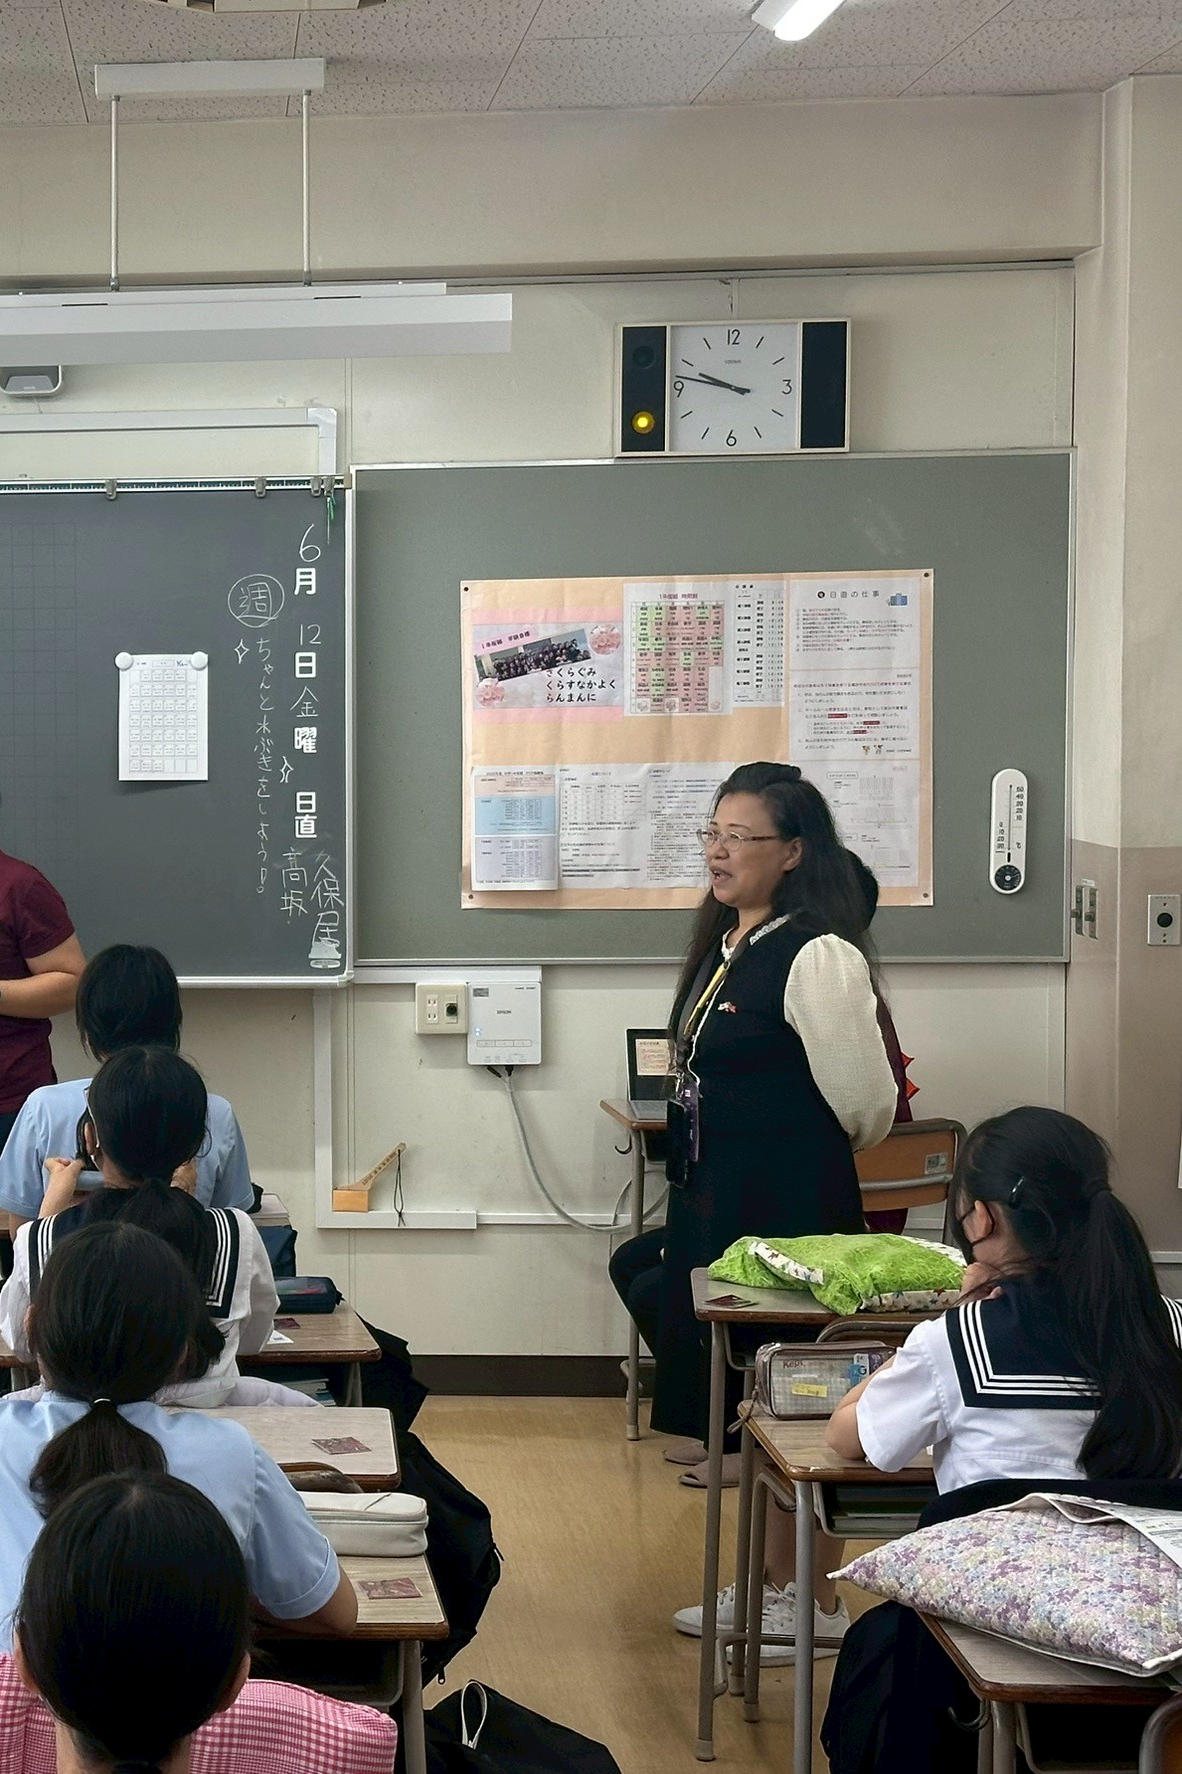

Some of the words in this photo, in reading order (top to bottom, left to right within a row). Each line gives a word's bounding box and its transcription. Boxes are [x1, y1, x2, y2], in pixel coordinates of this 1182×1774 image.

[727, 329, 741, 345] 12
[673, 380, 685, 398] 9
[781, 379, 793, 395] 3
[726, 429, 738, 447] 6
[545, 667, 597, 677] さくらぐみ
[545, 679, 616, 690] くらすなかよく
[546, 692, 597, 703] らんまんに
